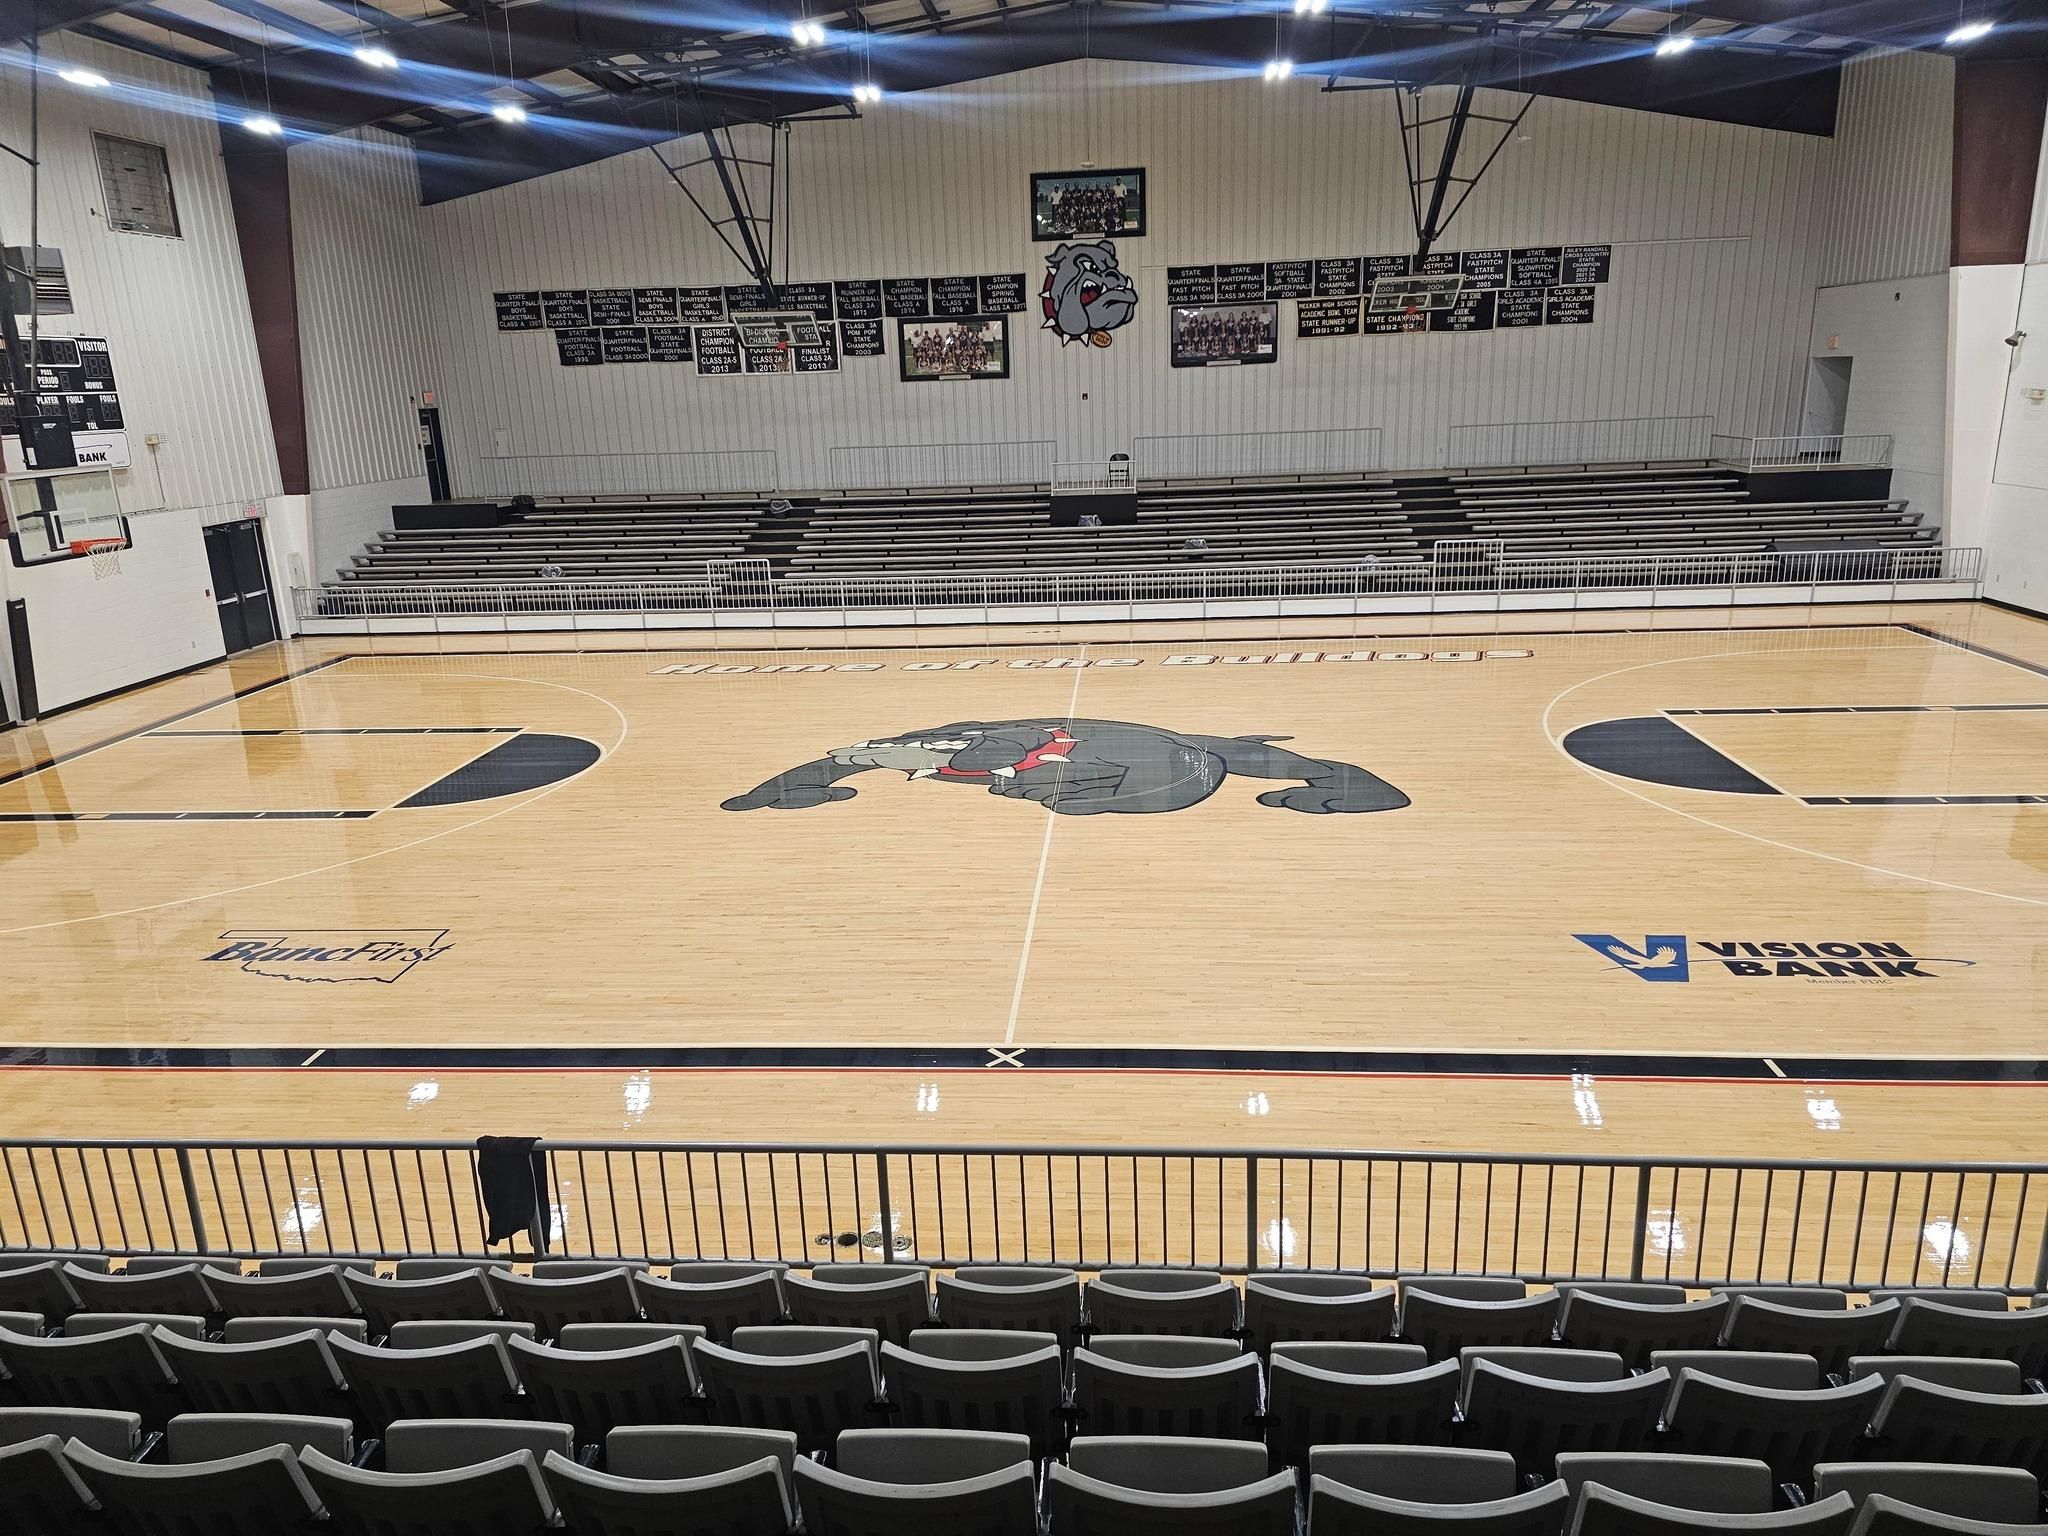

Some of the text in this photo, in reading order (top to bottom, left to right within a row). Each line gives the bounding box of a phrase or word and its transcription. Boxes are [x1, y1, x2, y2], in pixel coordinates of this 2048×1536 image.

[1301, 310, 1325, 318] ACADEMIC
[1388, 314, 1424, 322] CHAMPIONS
[1322, 318, 1356, 326] RUNNER-UP
[78, 341, 107, 352] VISITOR
[711, 365, 728, 373] 2013
[37, 376, 59, 384] PERIOD
[0, 397, 15, 405] OULS
[36, 396, 59, 404] PLAYER
[100, 395, 117, 403] FOULS
[79, 452, 107, 463] BANK
[646, 648, 1534, 676] Home of the Bulldogs
[200, 941, 456, 962] BancFirst
[1696, 942, 1913, 958] VISION
[1721, 960, 1940, 978] BANK
[1806, 977, 1857, 985] Member
